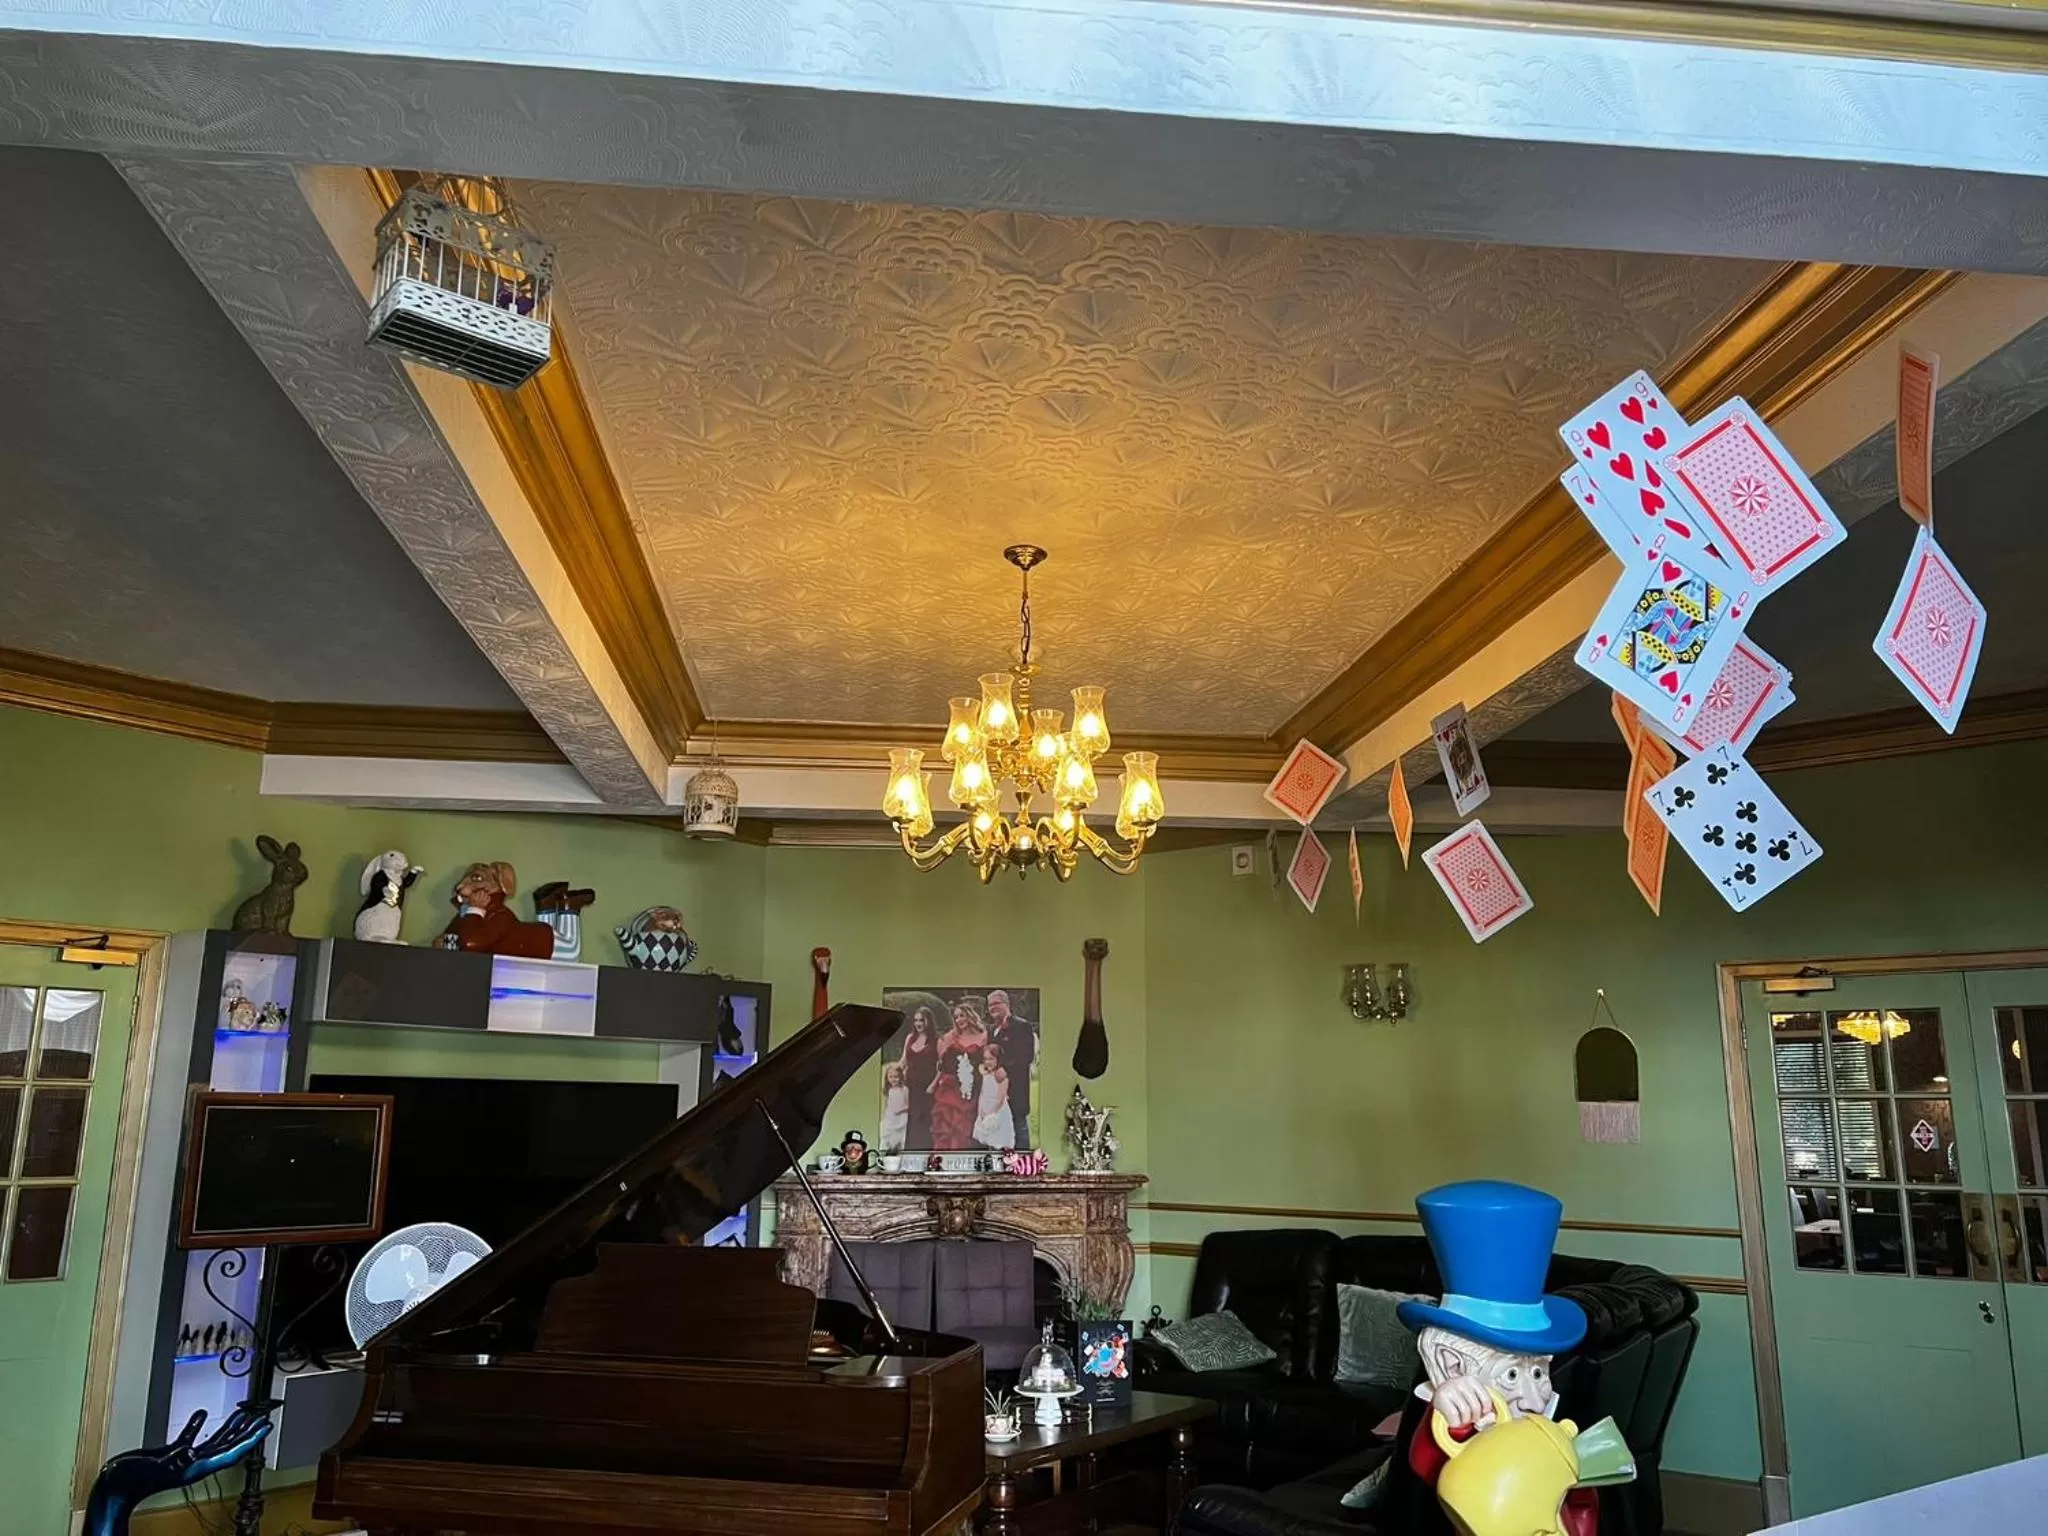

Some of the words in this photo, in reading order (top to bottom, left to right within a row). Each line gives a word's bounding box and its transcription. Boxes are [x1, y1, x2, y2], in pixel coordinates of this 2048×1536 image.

[1570, 476, 1584, 493] 7
[1717, 745, 1730, 761] 7
[1652, 791, 1664, 805] 7
[1801, 840, 1814, 856] 7
[1733, 887, 1746, 903] 7
